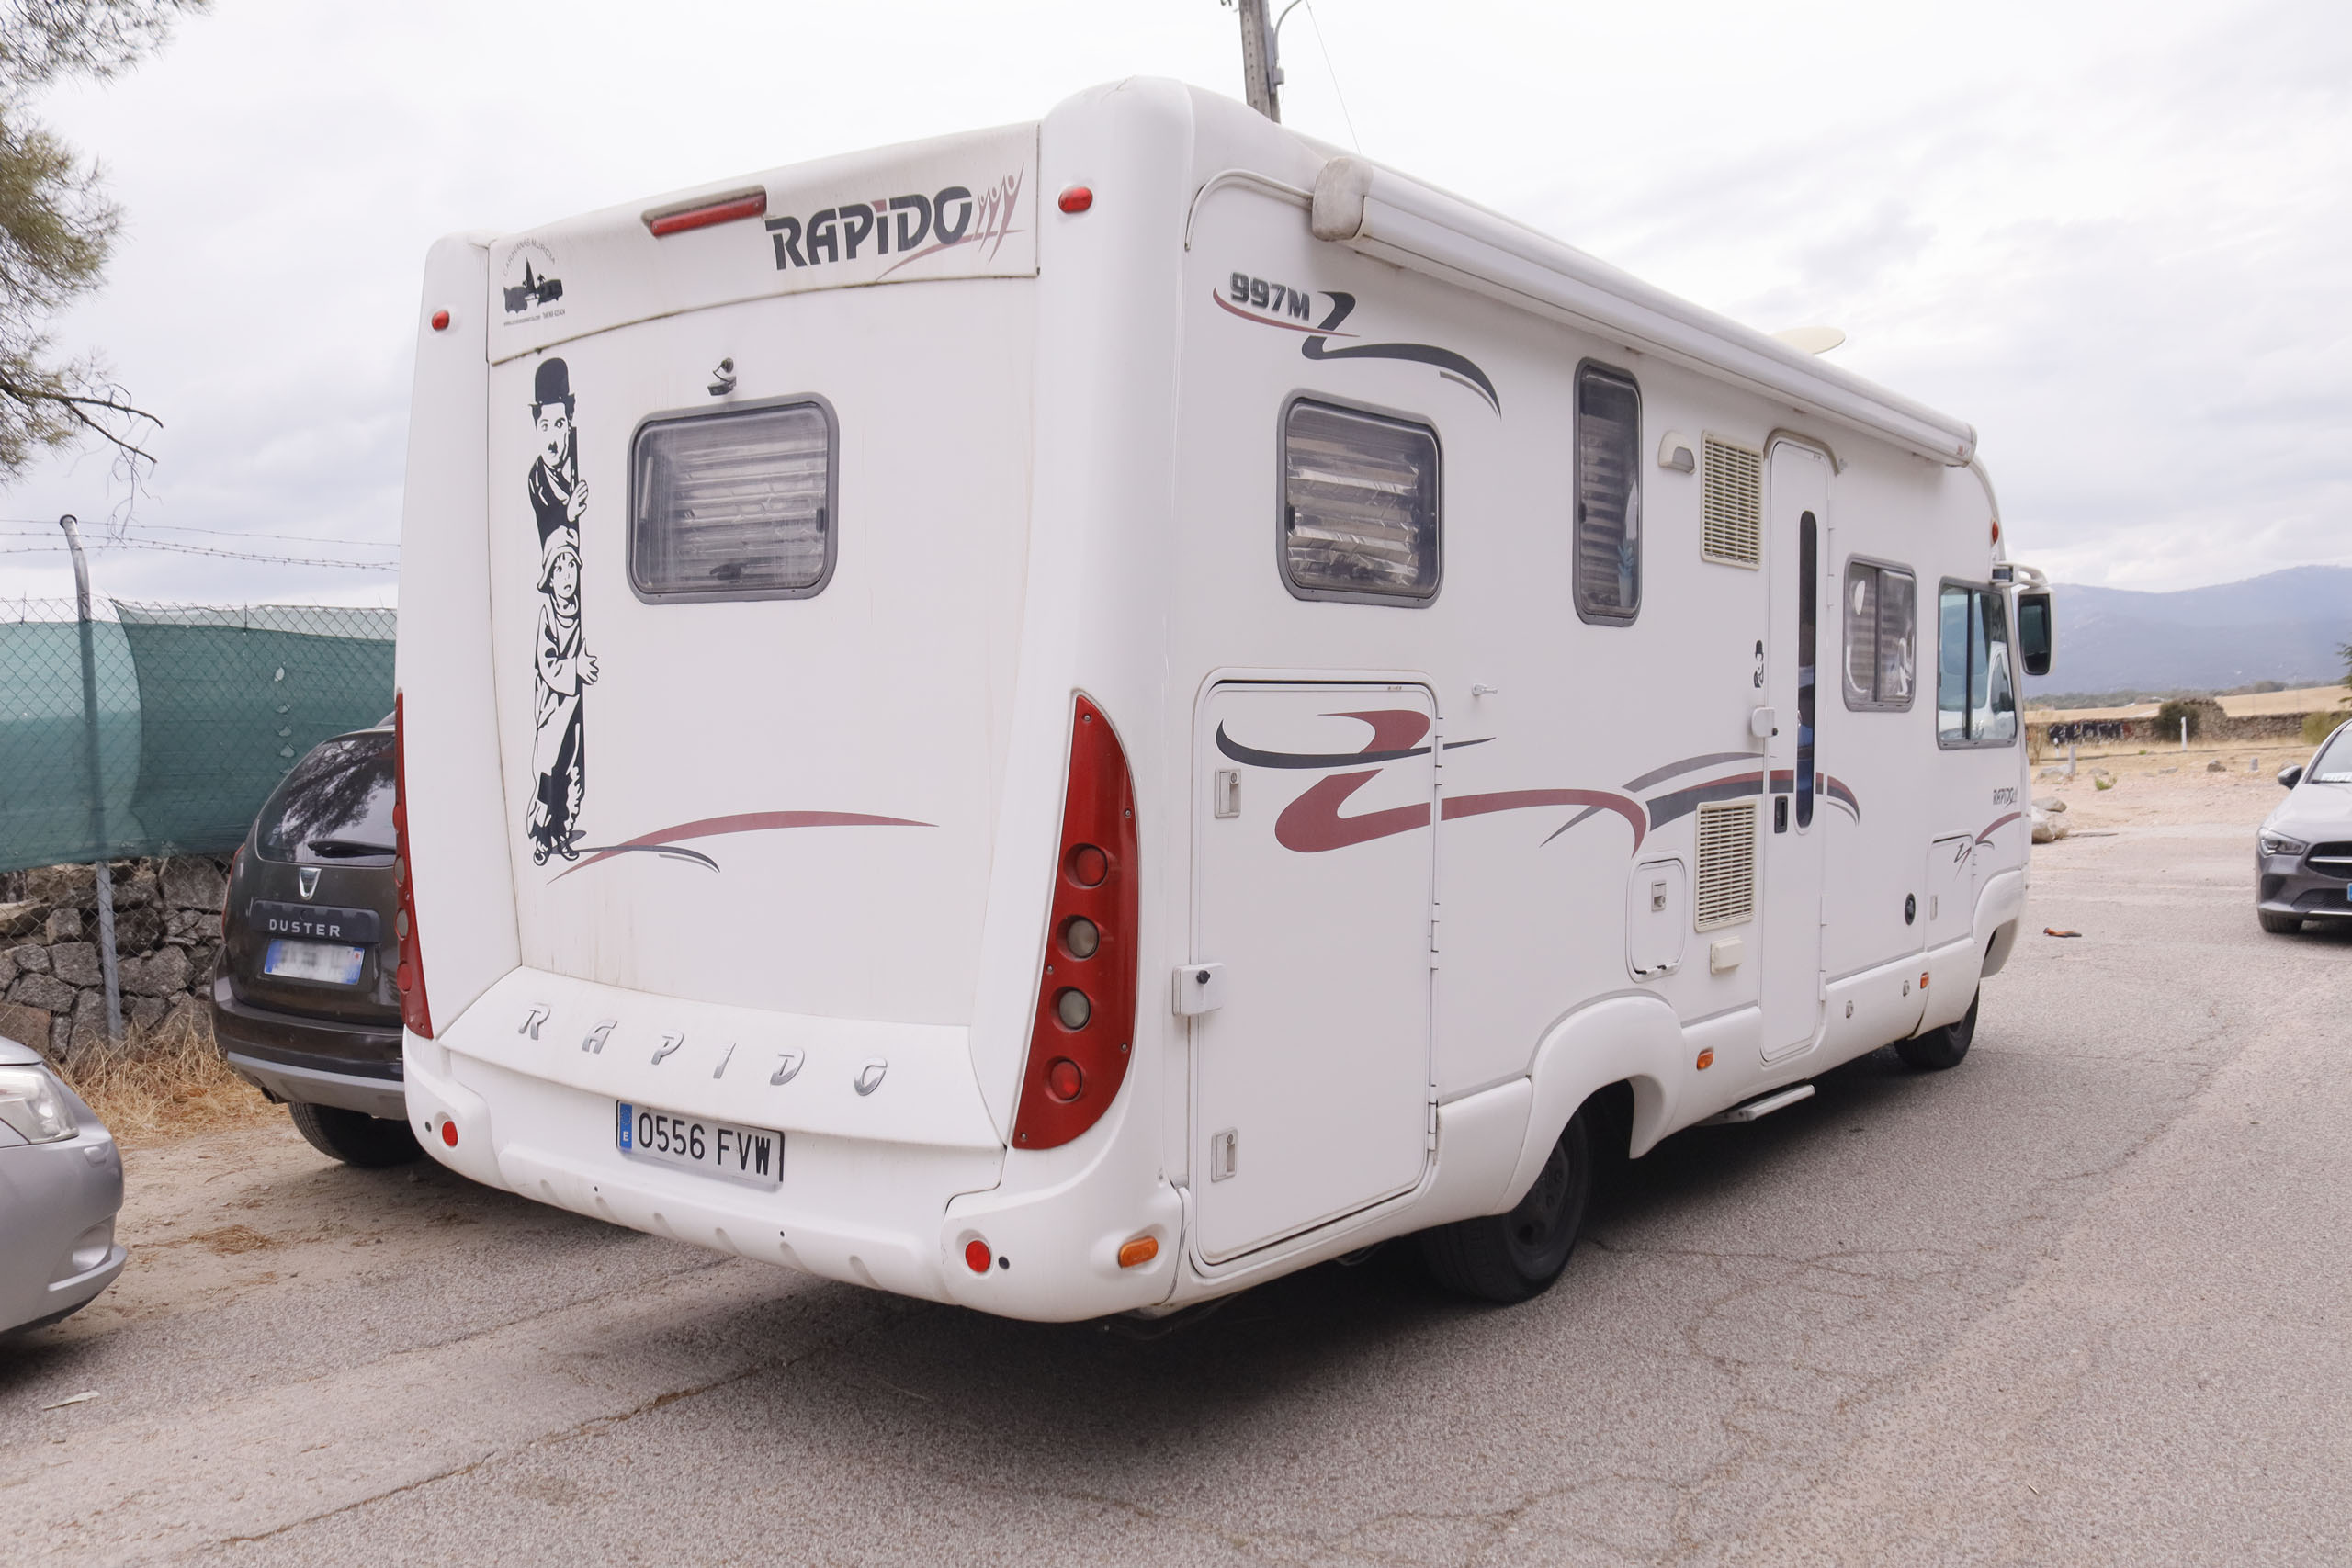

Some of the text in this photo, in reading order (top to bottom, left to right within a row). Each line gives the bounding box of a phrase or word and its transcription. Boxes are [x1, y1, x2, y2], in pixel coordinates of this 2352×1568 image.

[1229, 272, 1311, 321] 997M
[269, 919, 341, 937] DUSTER
[623, 1112, 771, 1177] E 0556 FVW
